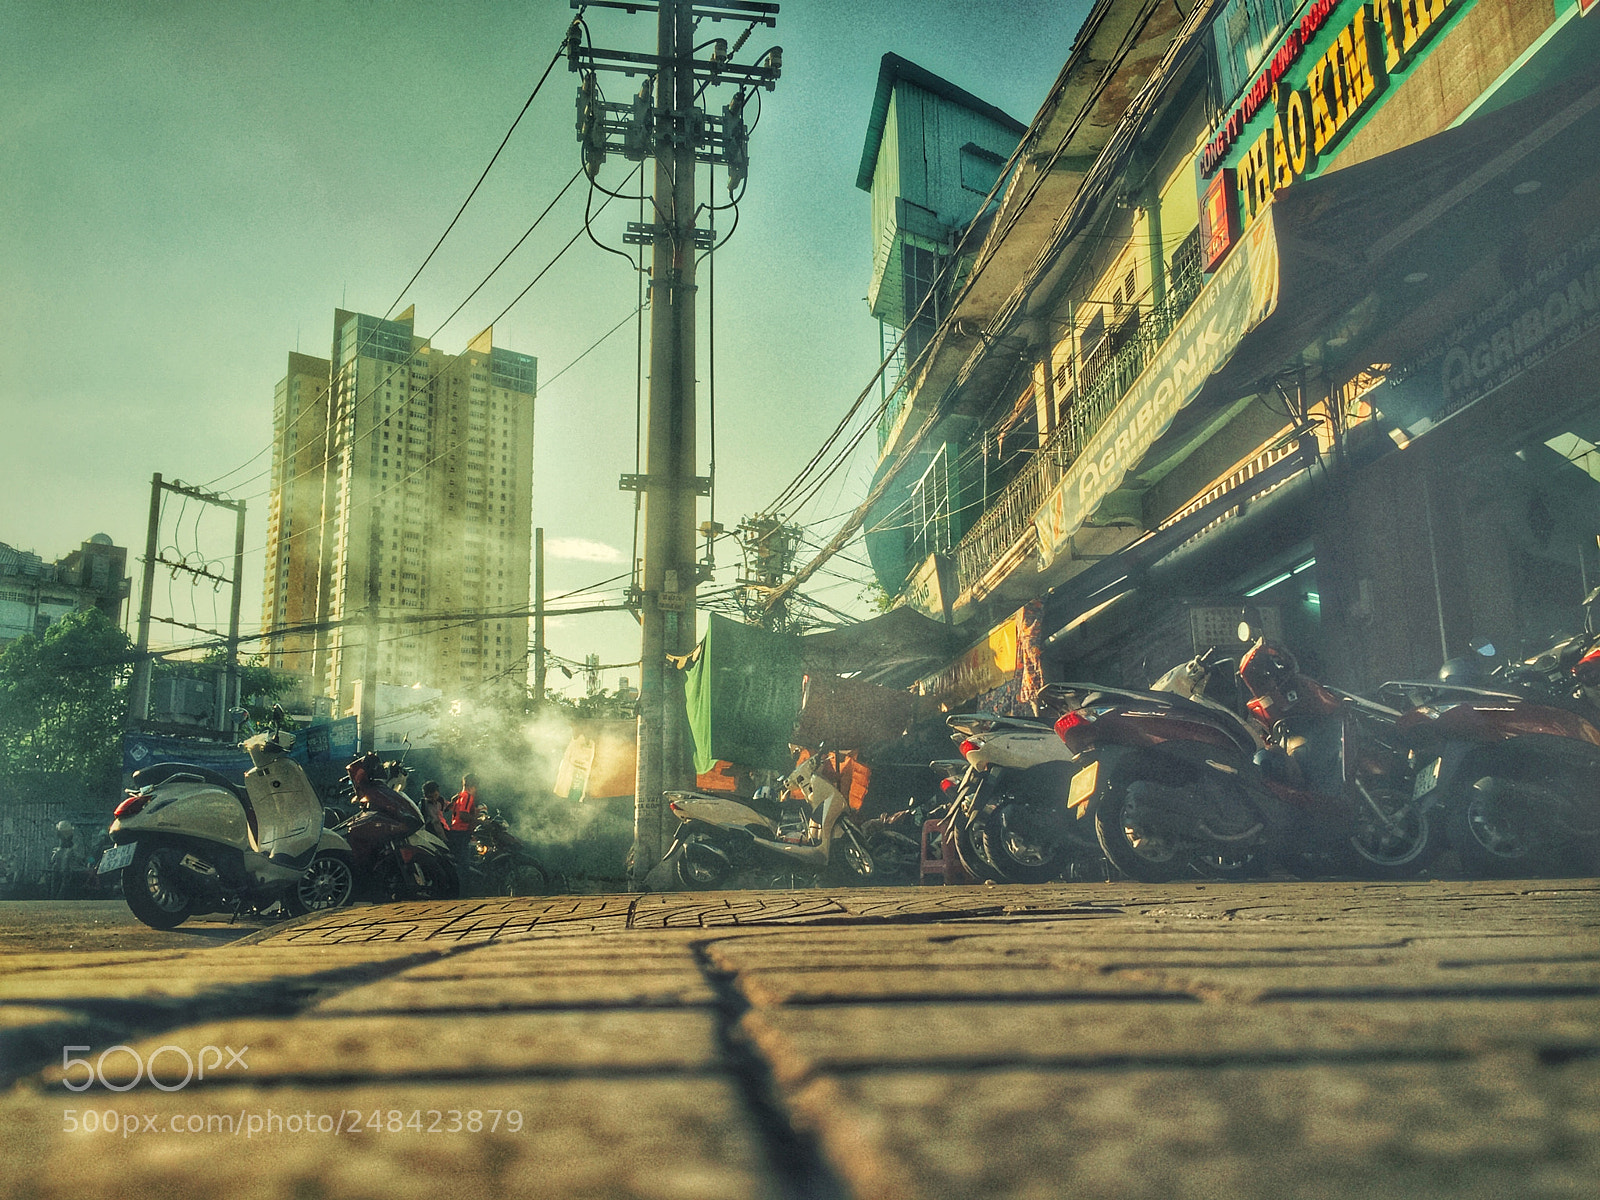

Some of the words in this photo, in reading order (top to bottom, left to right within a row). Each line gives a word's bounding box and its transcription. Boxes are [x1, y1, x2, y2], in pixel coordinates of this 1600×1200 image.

[1200, 134, 1225, 175] CÔNG
[1225, 110, 1238, 144] TY
[1240, 72, 1268, 124] TNHH
[1270, 31, 1298, 83] KINH
[1237, 82, 1306, 233] THẢO
[1307, 4, 1375, 156] KIM
[1221, 252, 1242, 288] NAM
[1079, 313, 1221, 505] AGRIBANK
